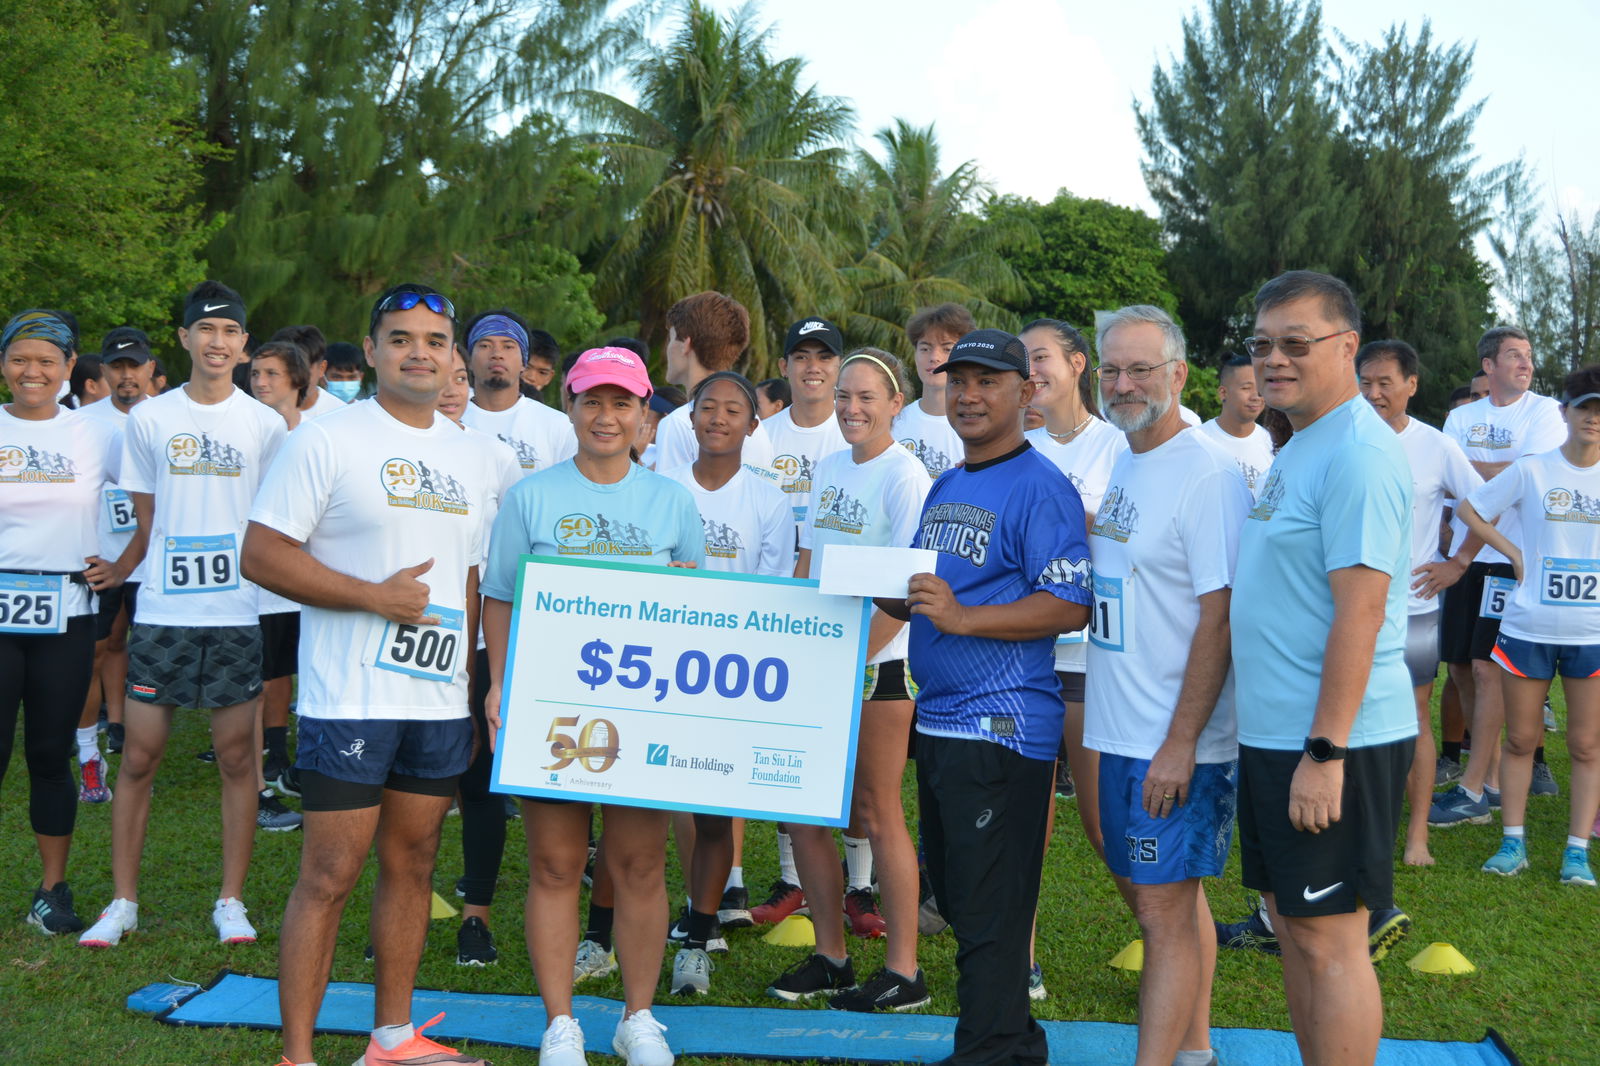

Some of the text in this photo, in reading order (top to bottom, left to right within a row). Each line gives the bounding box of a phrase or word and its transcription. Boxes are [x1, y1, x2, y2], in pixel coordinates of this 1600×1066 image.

[803, 321, 825, 329] NIKE
[956, 342, 995, 350] TOKYO 2020
[171, 438, 197, 457] 50
[21, 470, 50, 482] 10K
[194, 462, 218, 475] 10K
[387, 464, 416, 486] 50
[416, 493, 444, 511] 10K
[560, 518, 592, 539] 50
[589, 541, 624, 555] 10K
[171, 554, 230, 586] 519
[1547, 573, 1598, 600] 502
[0, 594, 53, 626] 525
[535, 591, 844, 639] Northern Marianas Athletics
[391, 624, 456, 672] 500
[576, 638, 790, 703] $5,000
[540, 714, 622, 773] 50
[670, 754, 735, 776] Tan Holdings
[754, 752, 803, 769] Tan Siu Lin
[751, 767, 801, 784] Foundation
